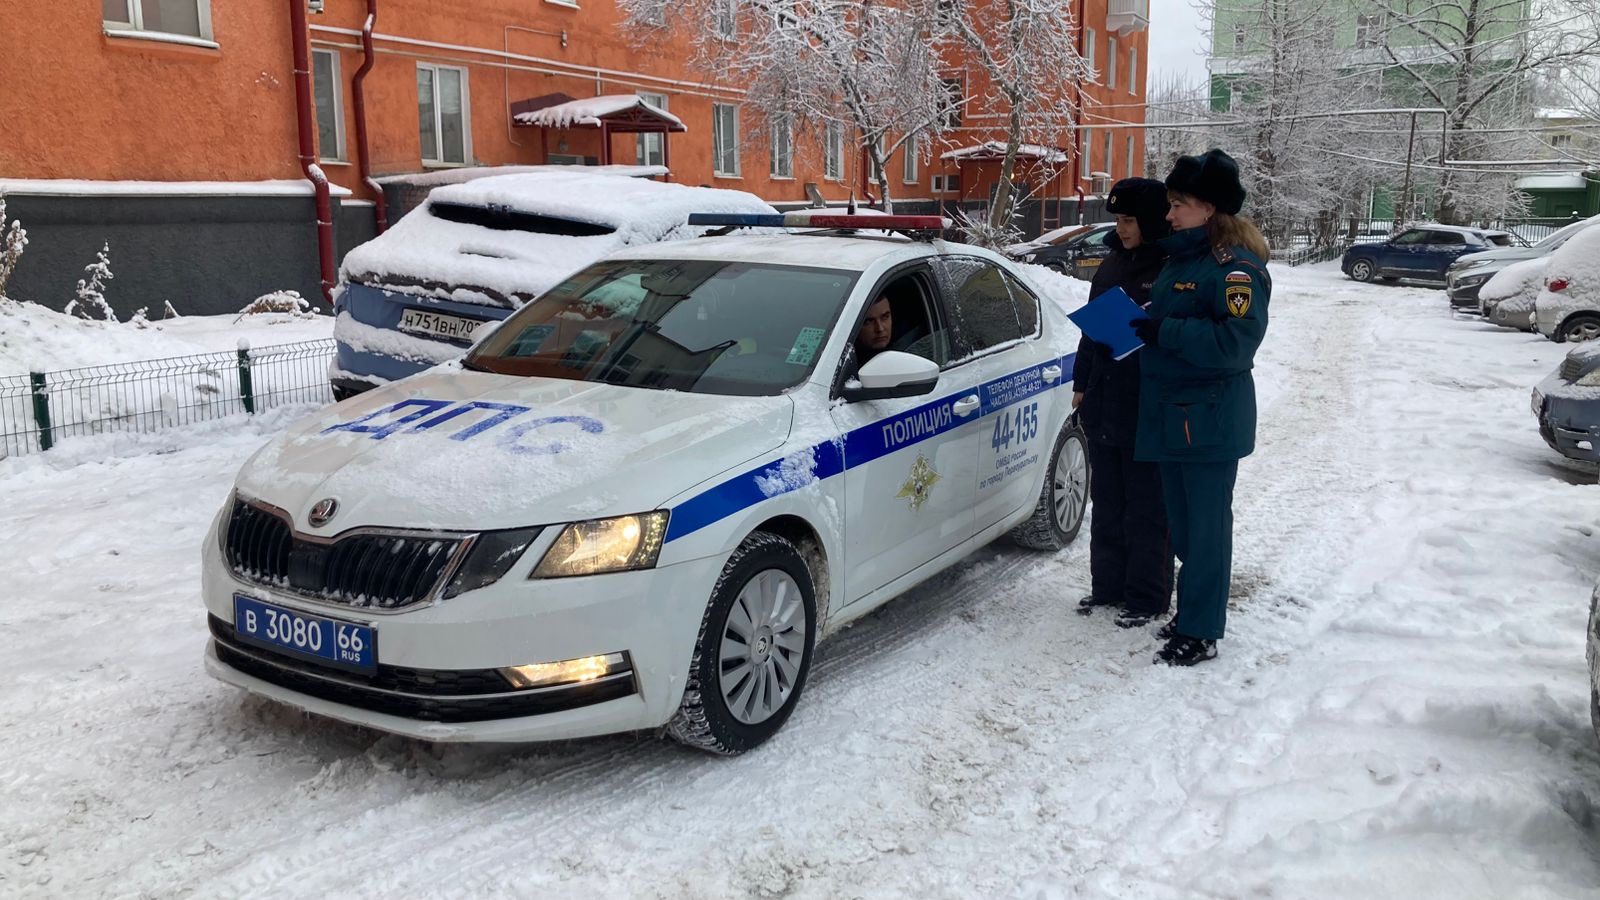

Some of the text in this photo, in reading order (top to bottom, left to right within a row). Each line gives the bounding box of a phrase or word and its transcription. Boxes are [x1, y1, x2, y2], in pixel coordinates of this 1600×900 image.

[987, 378, 1013, 394] ТЕЛЕФОН
[320, 398, 604, 454] ДПС
[882, 402, 952, 448] ПОЛИЦИЯ
[991, 402, 1039, 453] 44-155
[265, 608, 323, 651] 3080
[337, 625, 364, 652] 66
[341, 650, 361, 662] RUS
